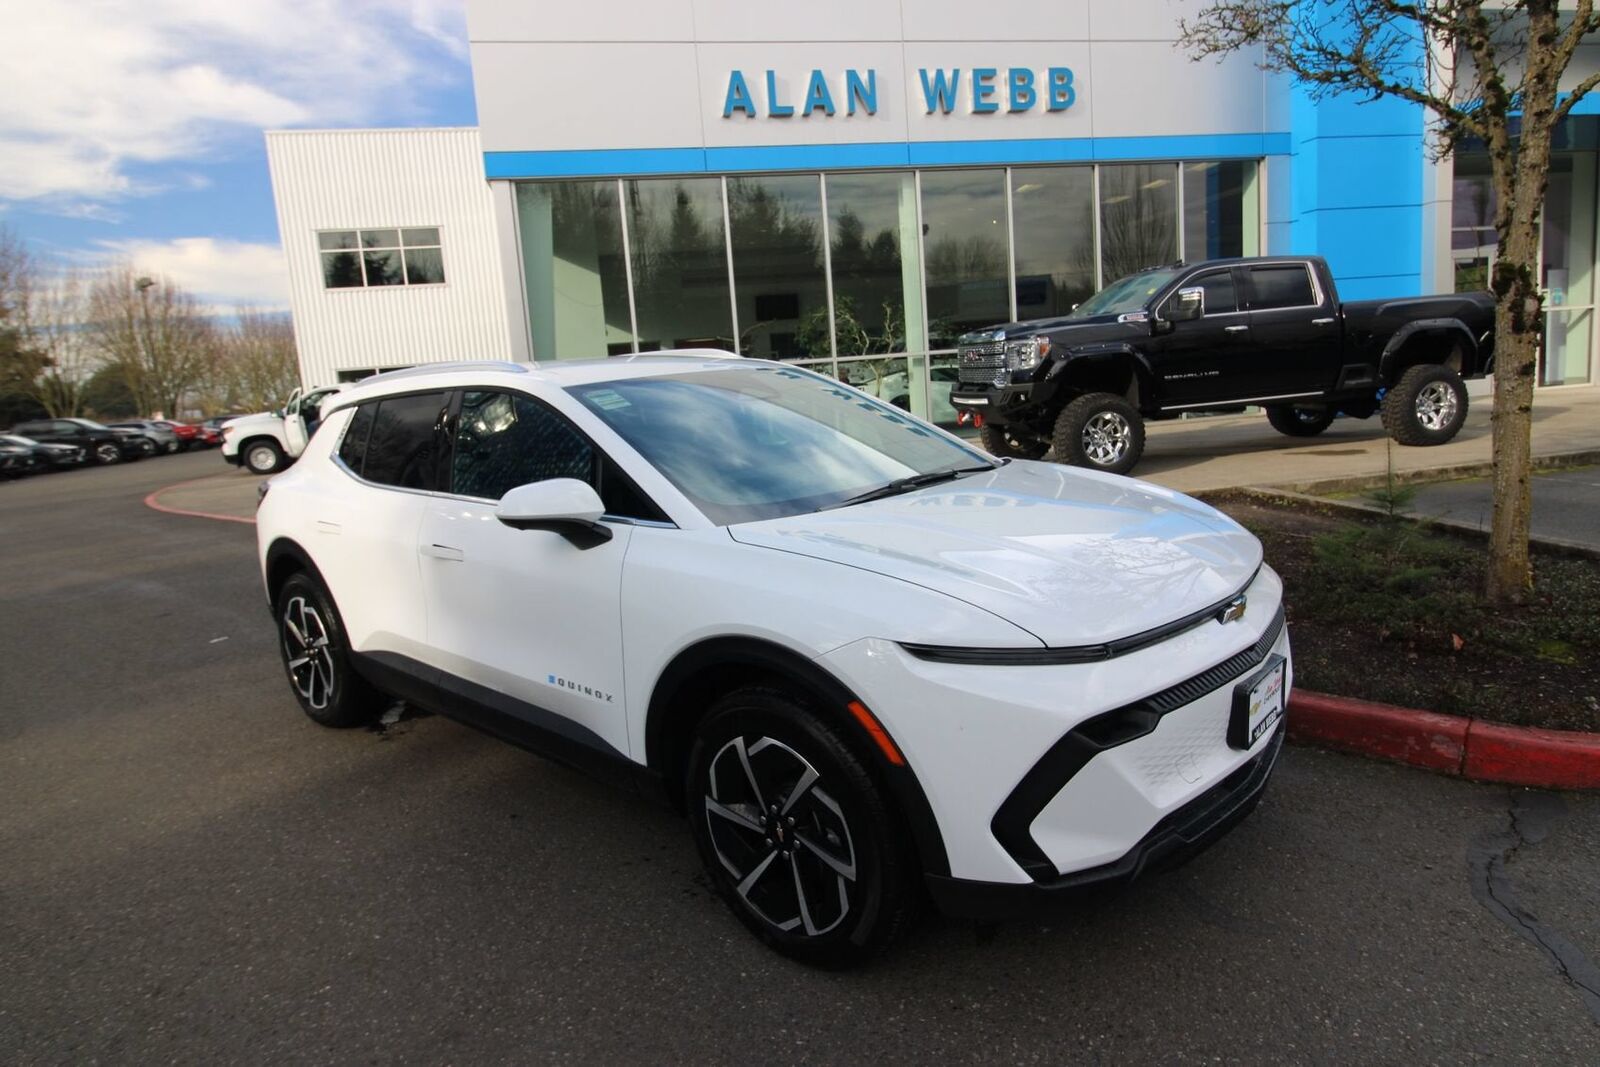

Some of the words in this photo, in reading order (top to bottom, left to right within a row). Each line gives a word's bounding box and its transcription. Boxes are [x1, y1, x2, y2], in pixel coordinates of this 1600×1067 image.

[722, 69, 878, 119] ALAN
[917, 67, 1077, 116] WEBB
[548, 674, 614, 703] EQUINOX
